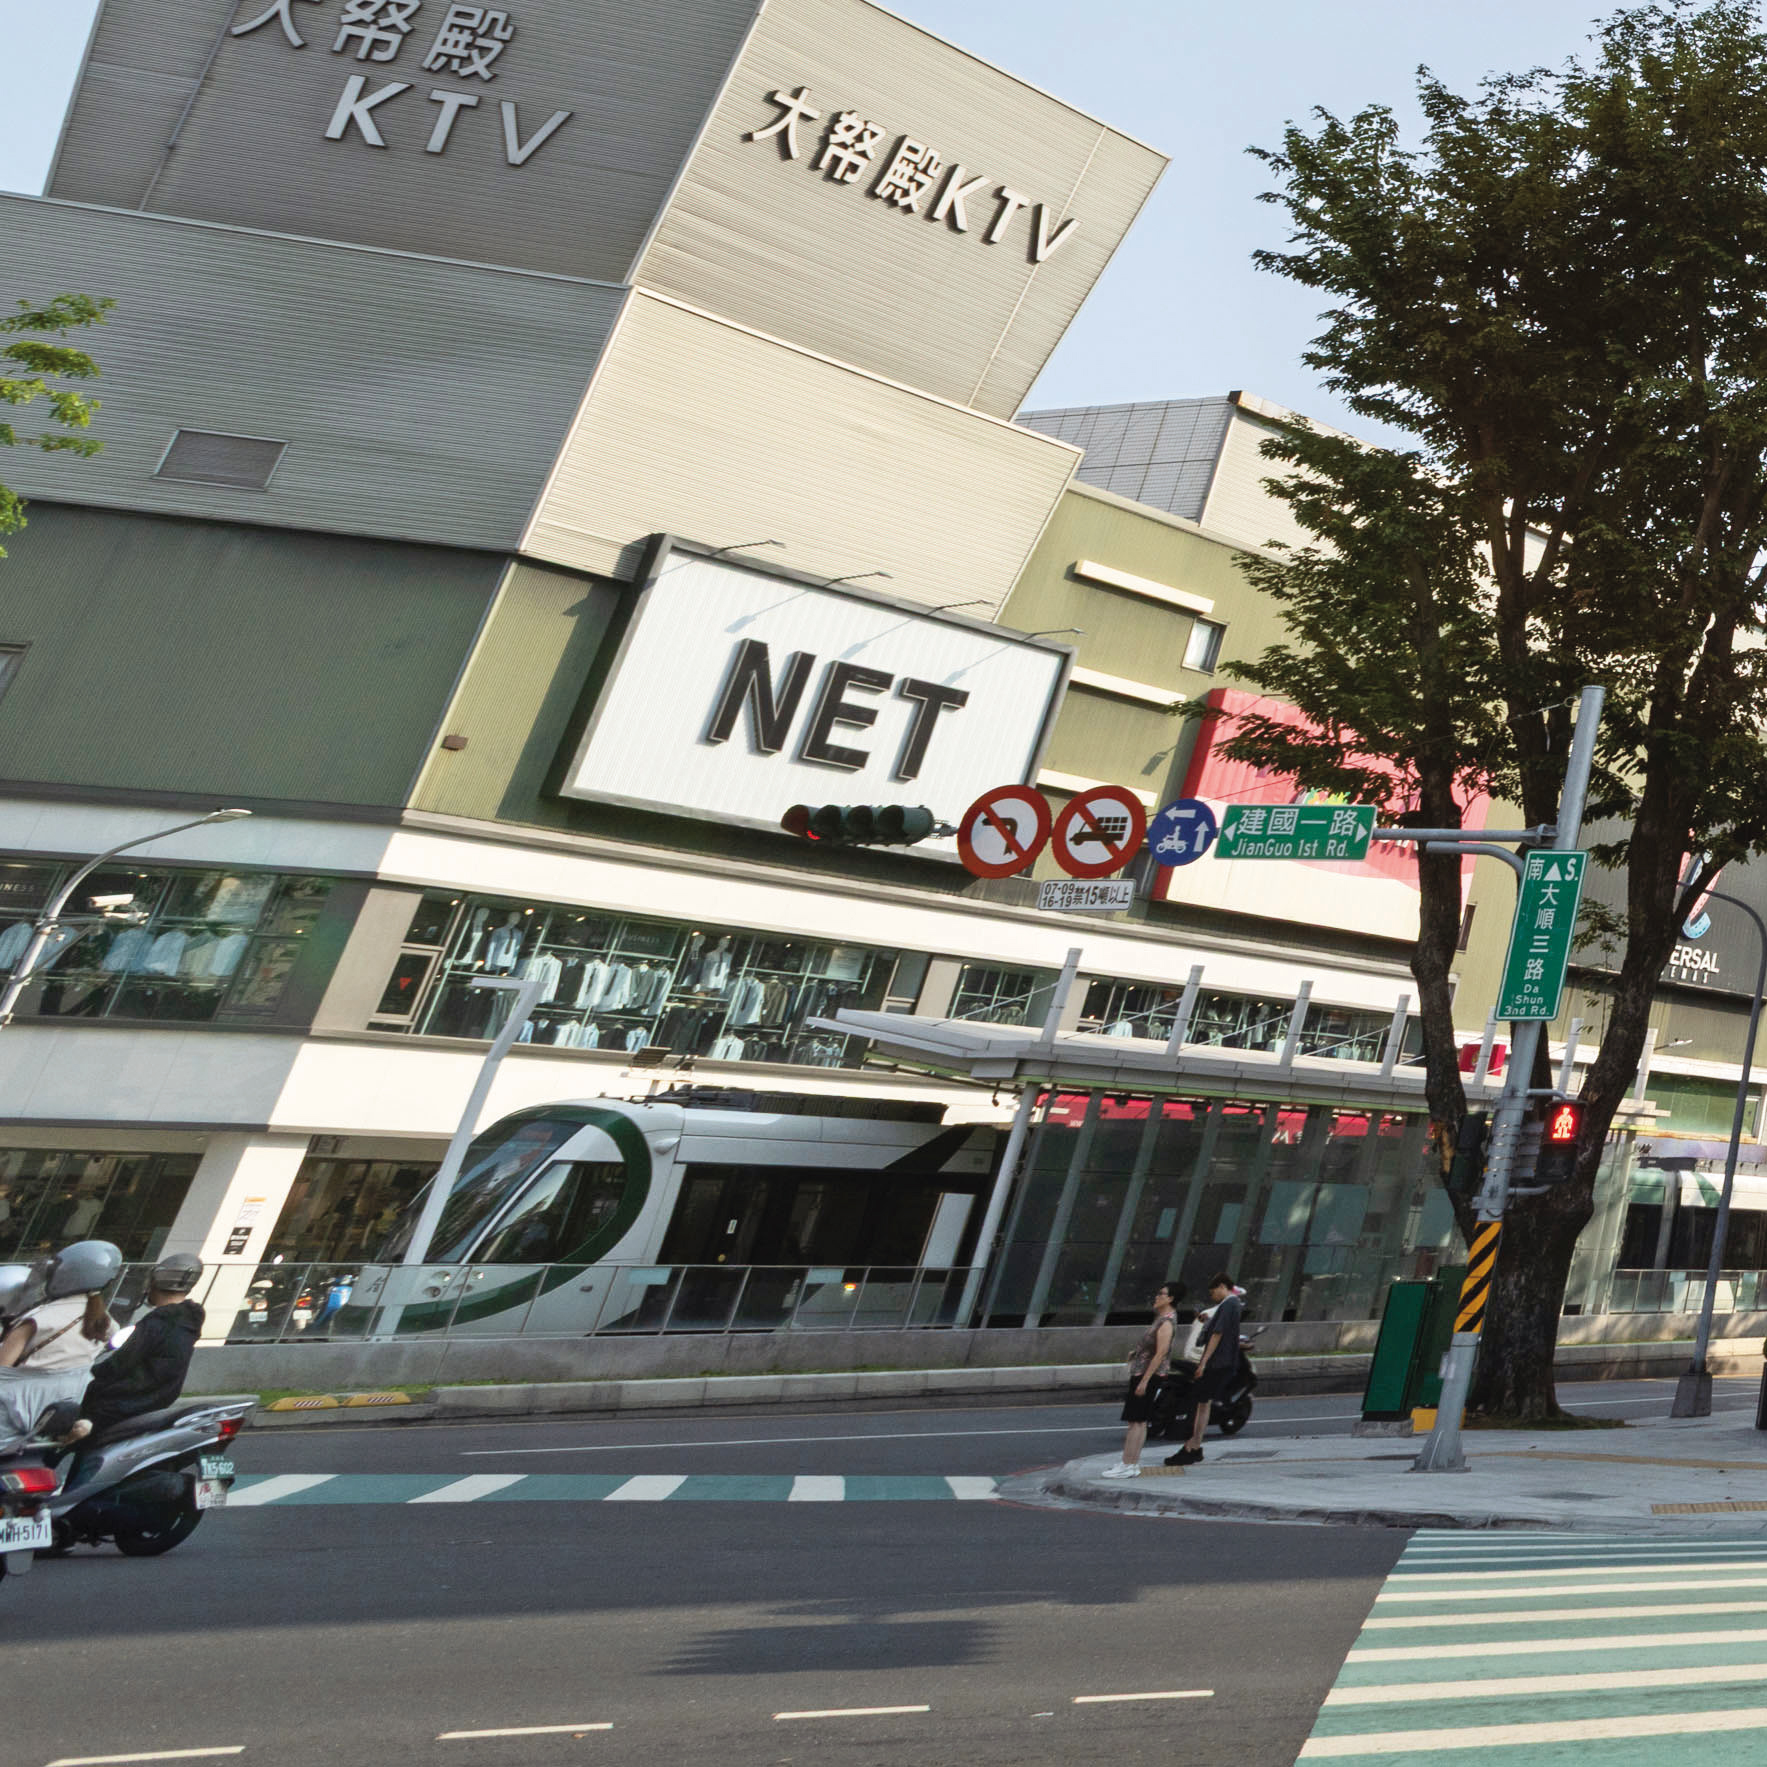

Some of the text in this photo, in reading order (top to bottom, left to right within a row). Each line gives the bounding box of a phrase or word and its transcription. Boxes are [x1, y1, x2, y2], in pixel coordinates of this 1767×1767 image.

[323, 74, 575, 167] KTV
[705, 637, 970, 781] NET
[1237, 807, 1359, 837] 建國一路
[1231, 839, 1350, 857] JianGuo 1st Rd.
[1527, 858, 1545, 881] 南
[1042, 895, 1073, 908] 16-19
[1523, 883, 1560, 980] 大順三路
[1523, 984, 1539, 994] Da
[1514, 994, 1544, 1005] Shun
[1503, 1005, 1550, 1016] 3nd Rd.
